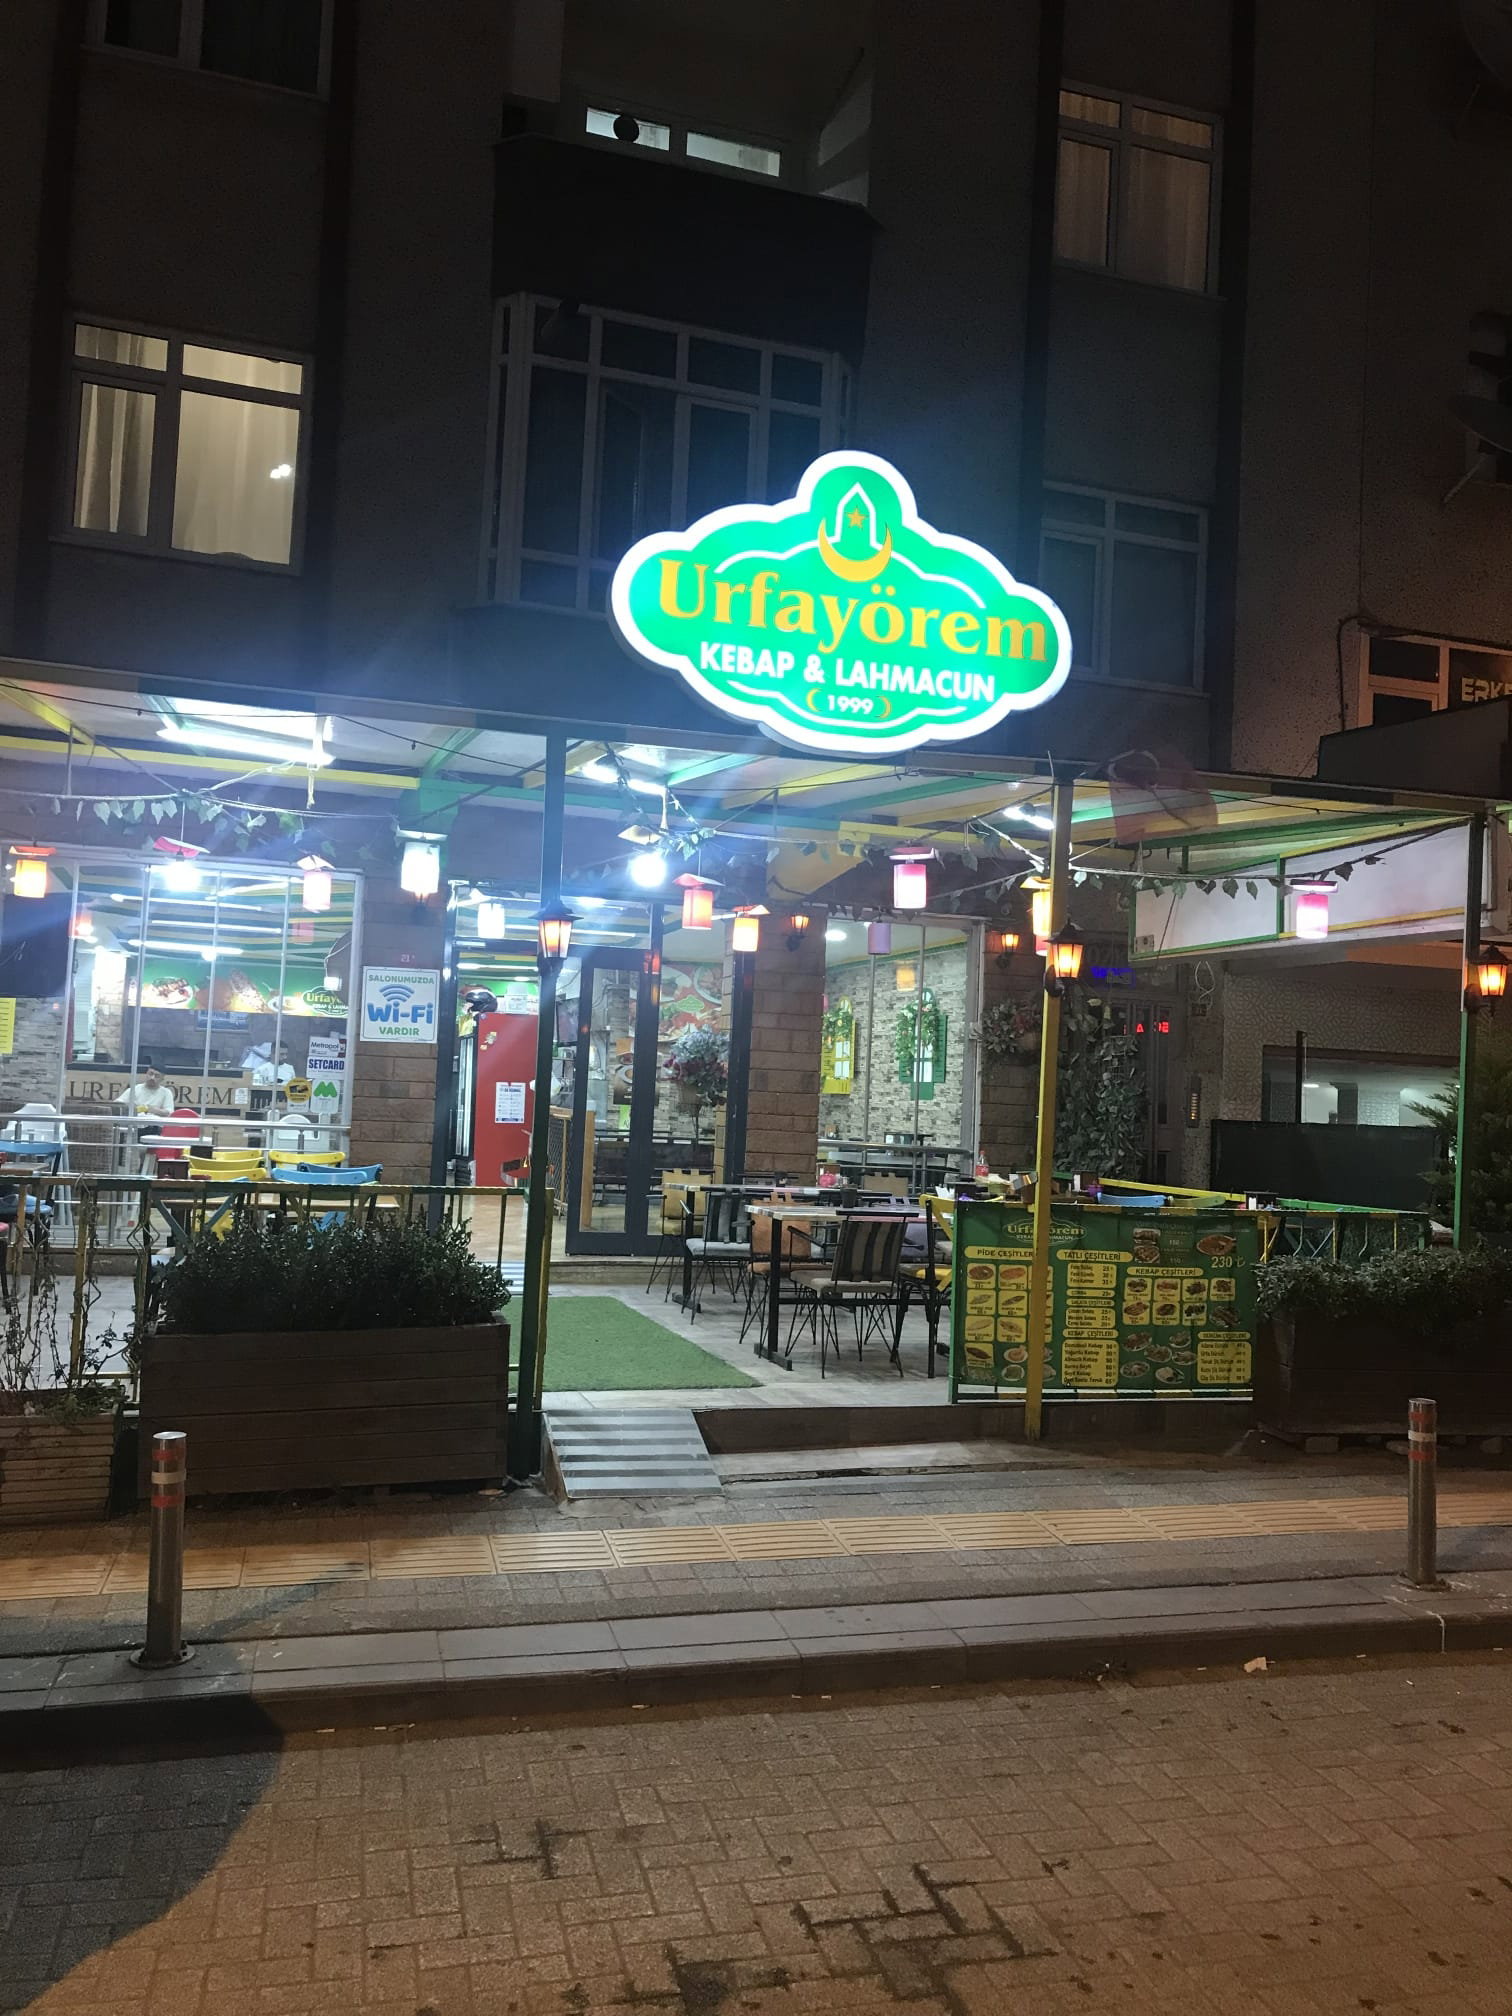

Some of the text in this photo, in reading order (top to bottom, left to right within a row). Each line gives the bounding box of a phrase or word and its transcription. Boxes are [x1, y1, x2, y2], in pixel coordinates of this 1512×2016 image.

[659, 558, 1048, 664] Urfayörem
[700, 641, 996, 703] KEBAP & LAHMACUN
[827, 694, 874, 716] 1999
[368, 974, 434, 985] SALONUMUZDA
[367, 1000, 434, 1025] Wi-Fi
[379, 1026, 420, 1036] VARDIR
[308, 1058, 345, 1071] SETCARD
[977, 1248, 995, 1256] PİDE
[1084, 1251, 1121, 1261] ÇEŞİTLERİ
[1211, 1256, 1232, 1268] 230
